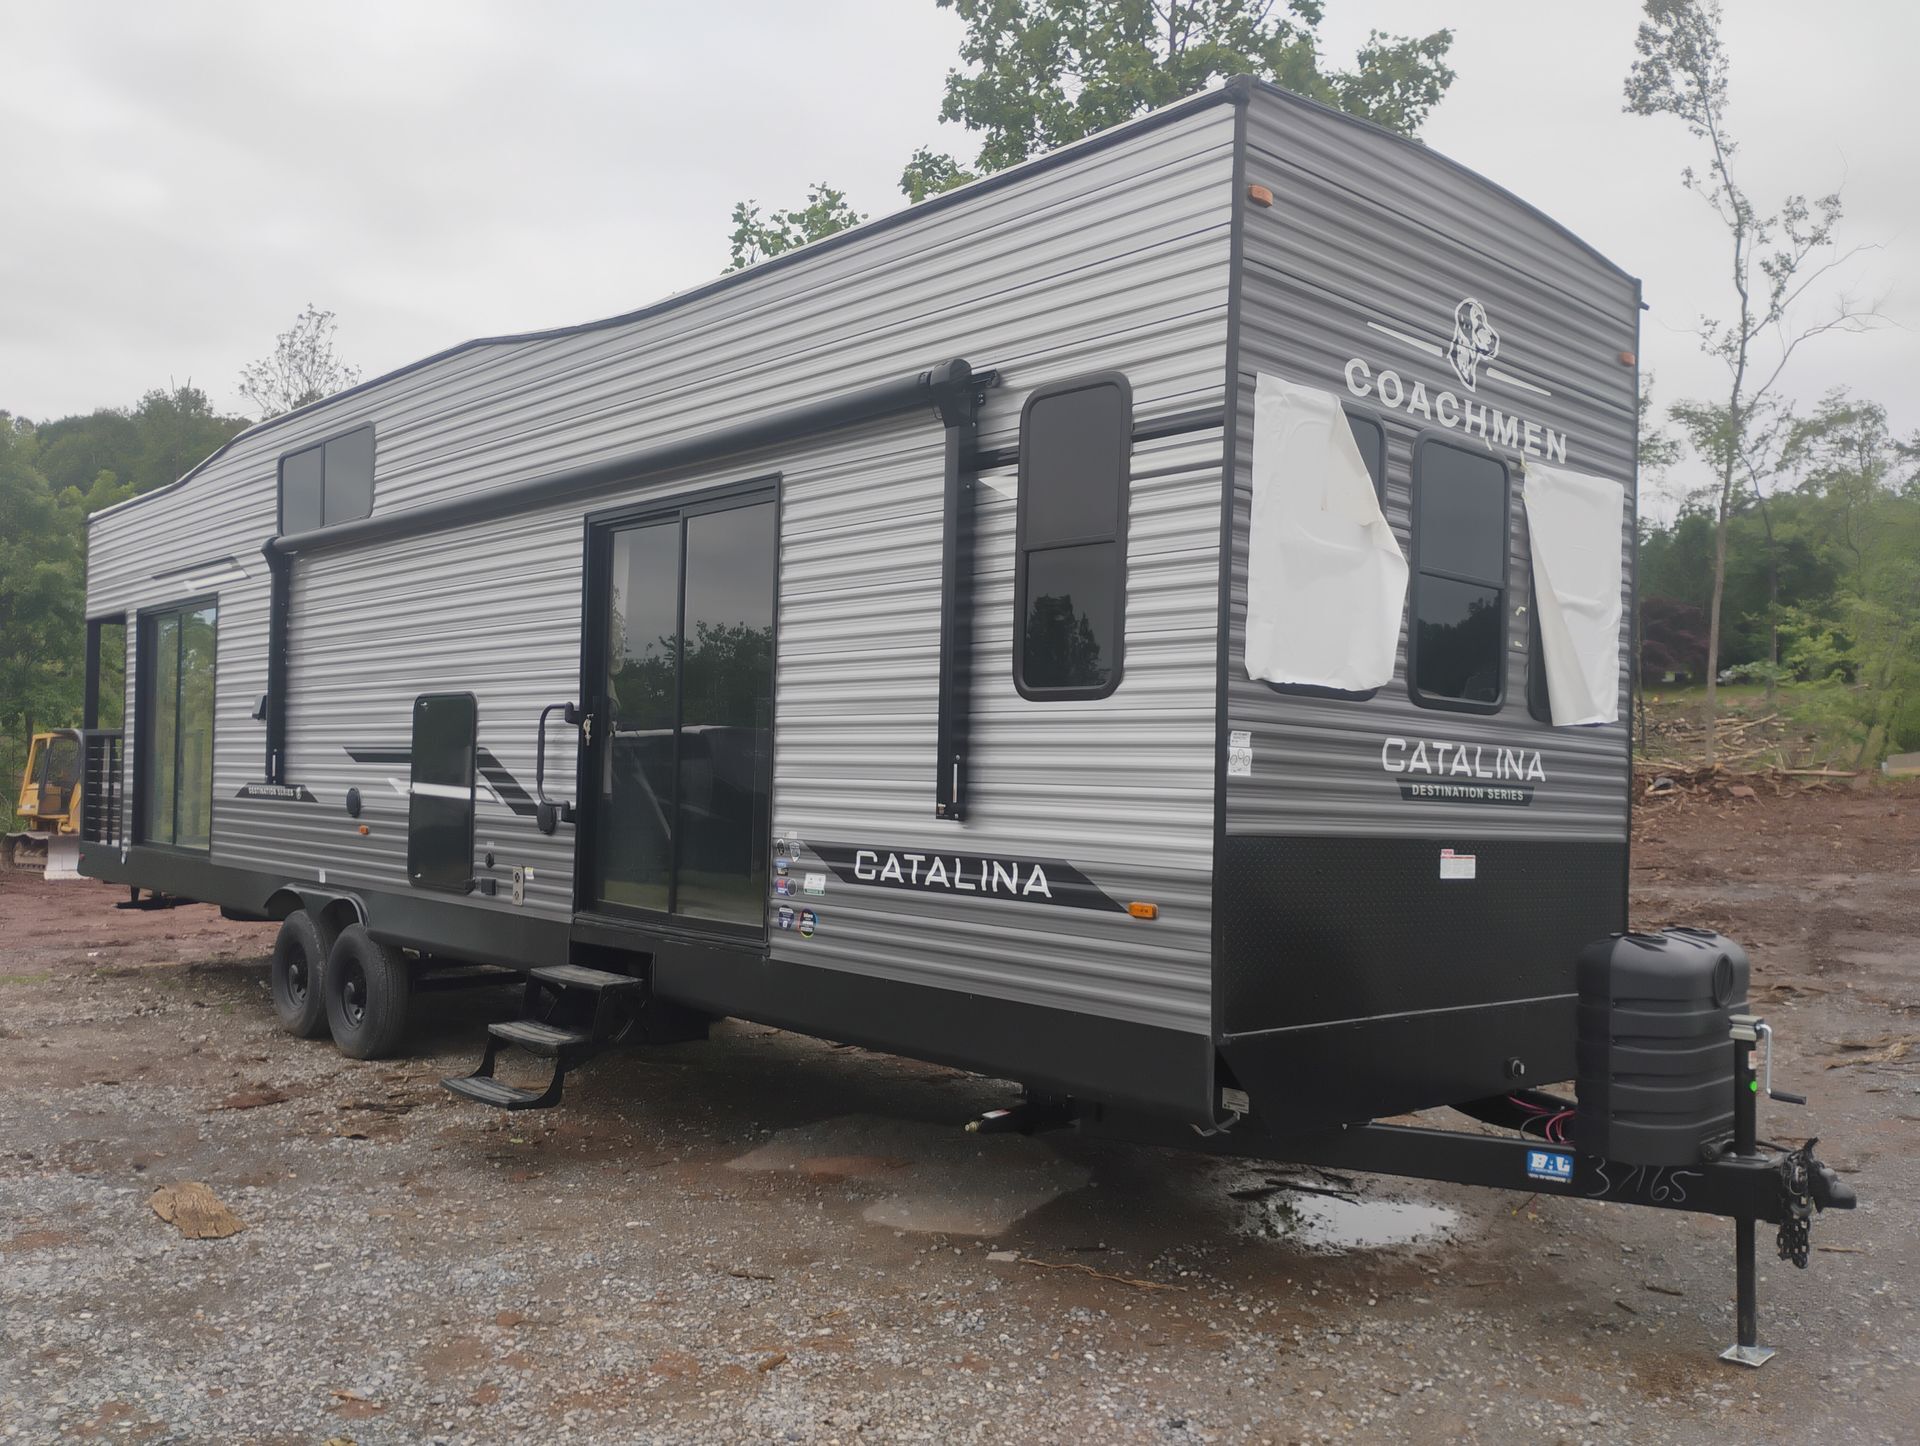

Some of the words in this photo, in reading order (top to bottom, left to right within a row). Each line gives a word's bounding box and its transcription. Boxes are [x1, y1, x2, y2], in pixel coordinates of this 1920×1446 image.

[1344, 357, 1567, 464] COACHMEN
[1382, 737, 1546, 782] CATALINA
[1411, 784, 1484, 799] DESTINATION
[1487, 788, 1524, 801] SERIES
[854, 849, 1053, 898] CATALINA
